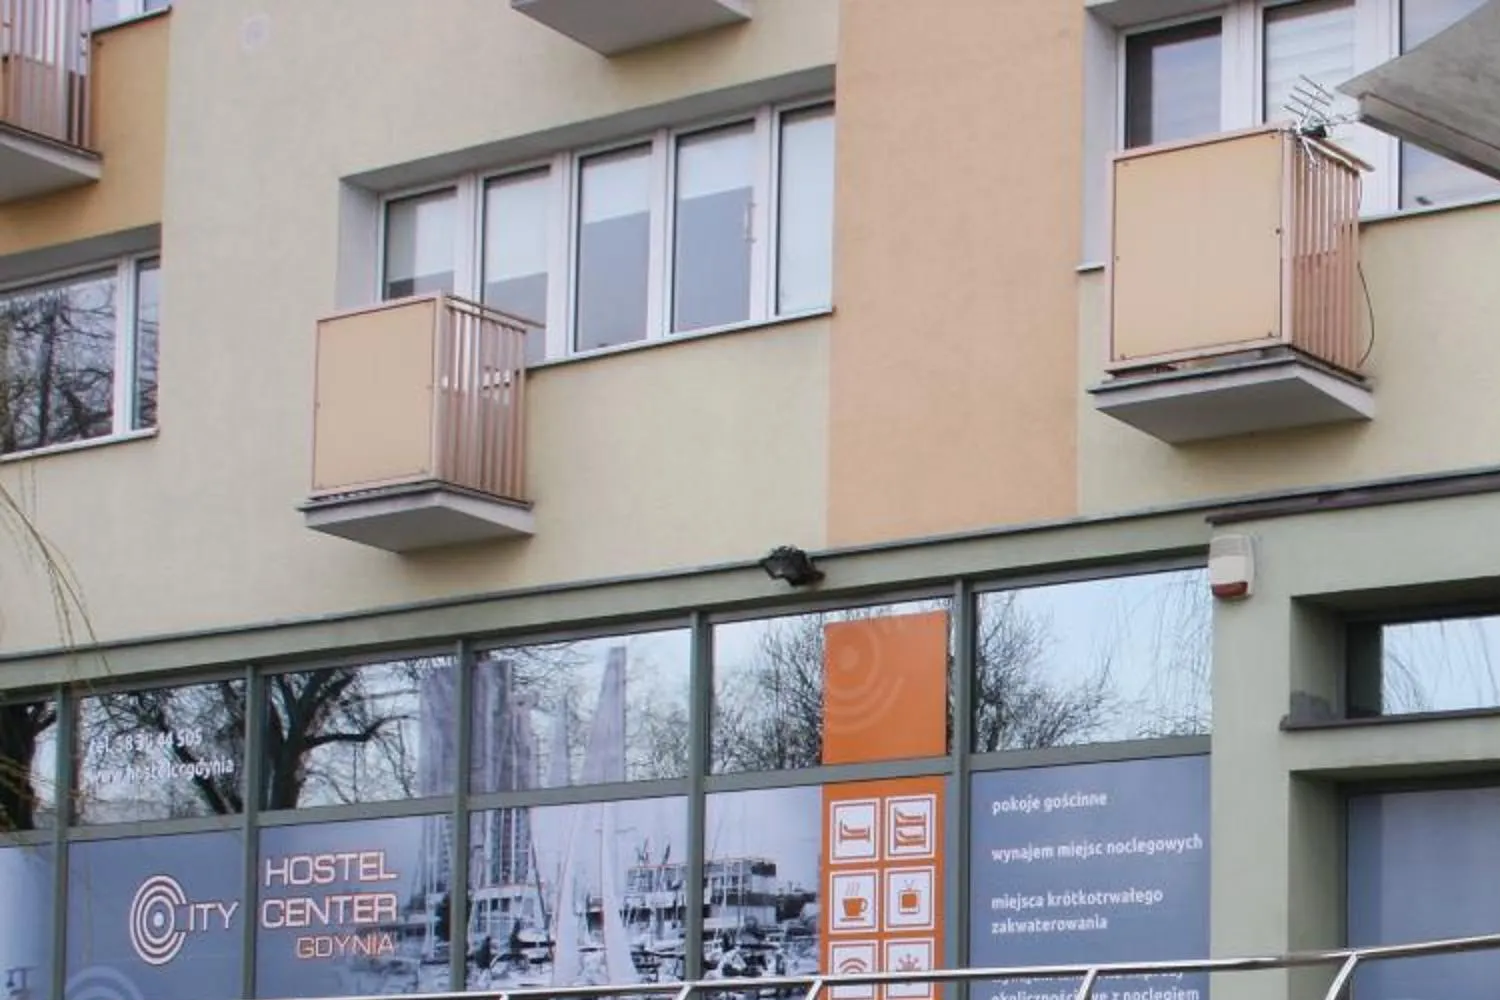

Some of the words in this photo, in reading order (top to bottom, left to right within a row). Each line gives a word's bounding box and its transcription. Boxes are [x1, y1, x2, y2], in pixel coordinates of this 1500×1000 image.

[992, 796, 1040, 815] pokoje
[1043, 792, 1107, 812] gościnne
[991, 846, 1053, 863] wynajem
[1057, 840, 1103, 859] miejsc
[1106, 833, 1203, 855] noclegowych
[265, 850, 398, 887] HOSTEL
[262, 893, 397, 929] CENTER
[991, 893, 1044, 911] miejsca
[1047, 885, 1163, 907] krótkotrwałego
[991, 914, 1108, 934] zakwaterowania
[296, 932, 396, 959] GDYNIA
